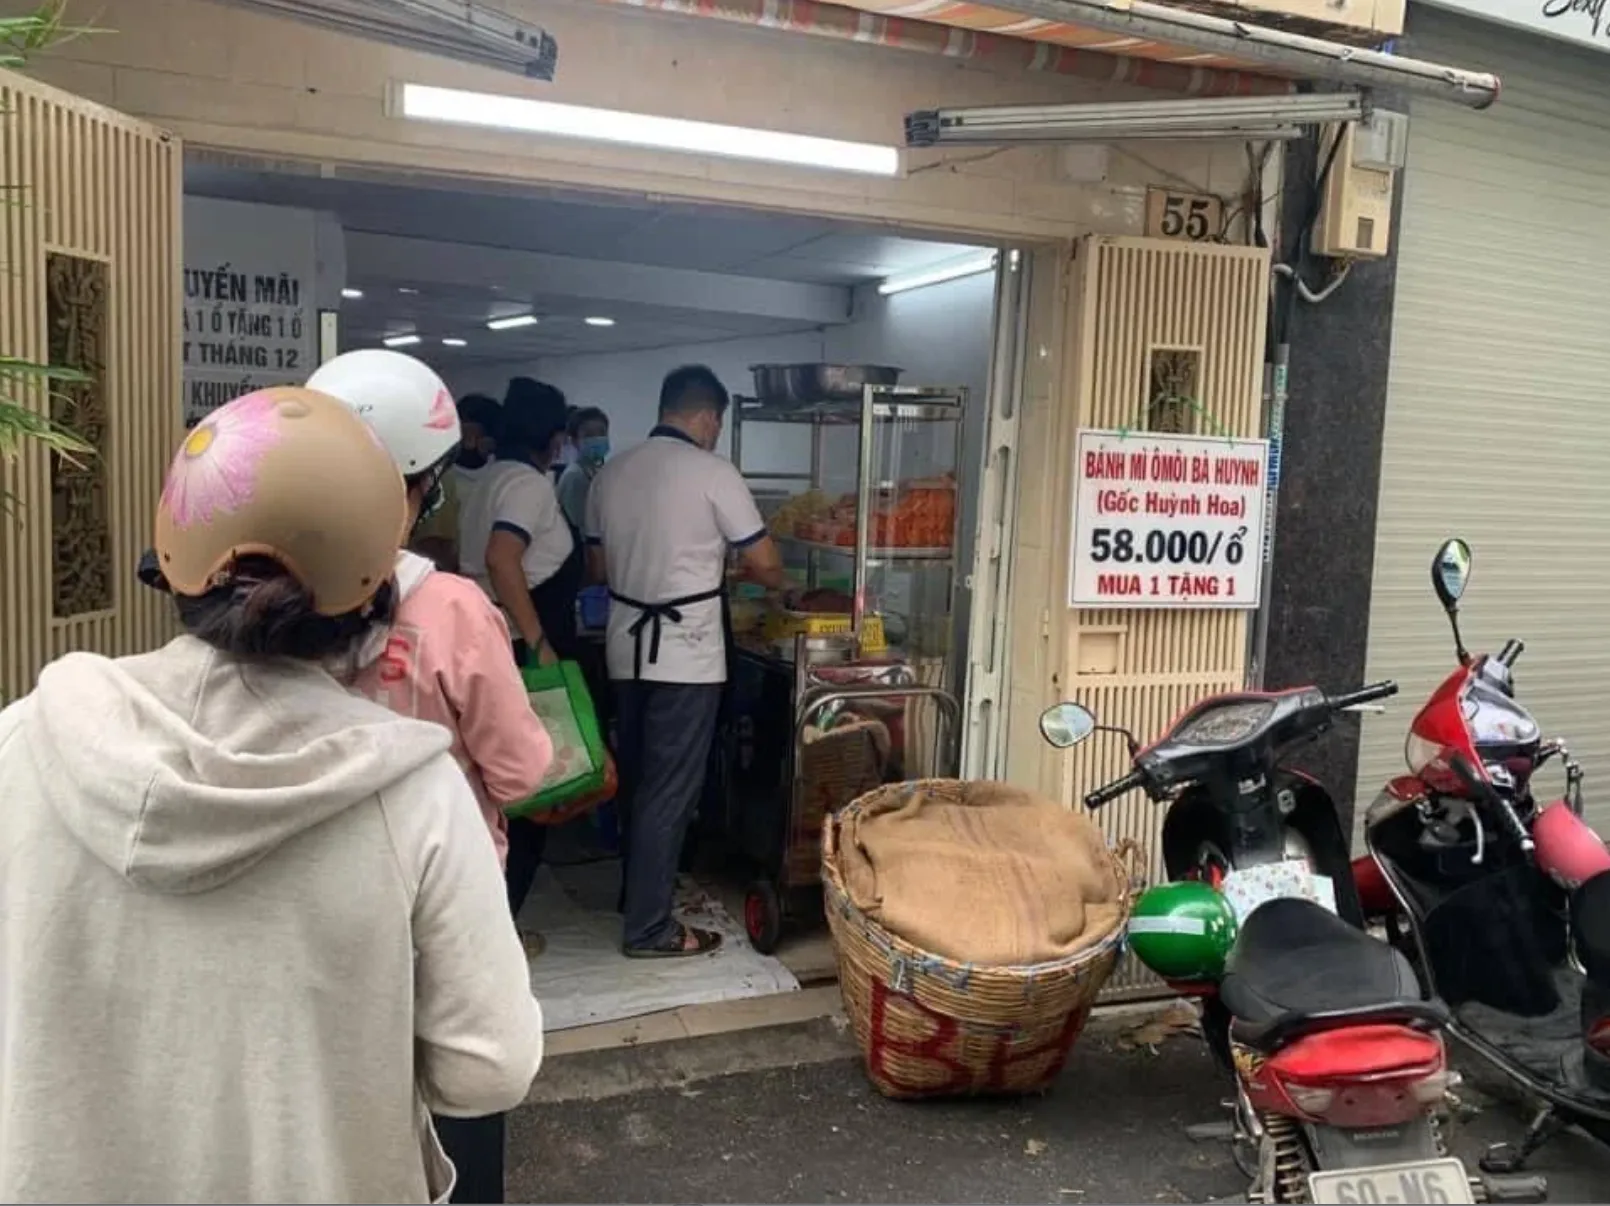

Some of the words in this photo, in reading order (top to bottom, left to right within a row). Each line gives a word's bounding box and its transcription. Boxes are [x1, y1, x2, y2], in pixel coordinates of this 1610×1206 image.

[1161, 197, 1209, 239] 55
[255, 272, 299, 306] MÃI
[196, 310, 203, 332] 1
[227, 307, 273, 340] TẶNG
[278, 316, 285, 338] 1
[199, 339, 268, 368] THÁNG
[274, 348, 299, 369] 12
[1085, 444, 1125, 480] BÁNH
[1097, 487, 1139, 514] (Gốc
[1145, 491, 1200, 518] Huỳnh
[1207, 494, 1246, 518] Hoa)
[1090, 526, 1248, 565] 58.000/ổ
[1097, 575, 1141, 596] MUA
[1150, 577, 1160, 595] 1
[1167, 572, 1219, 600] TẶNG
[1227, 577, 1236, 596] 1
